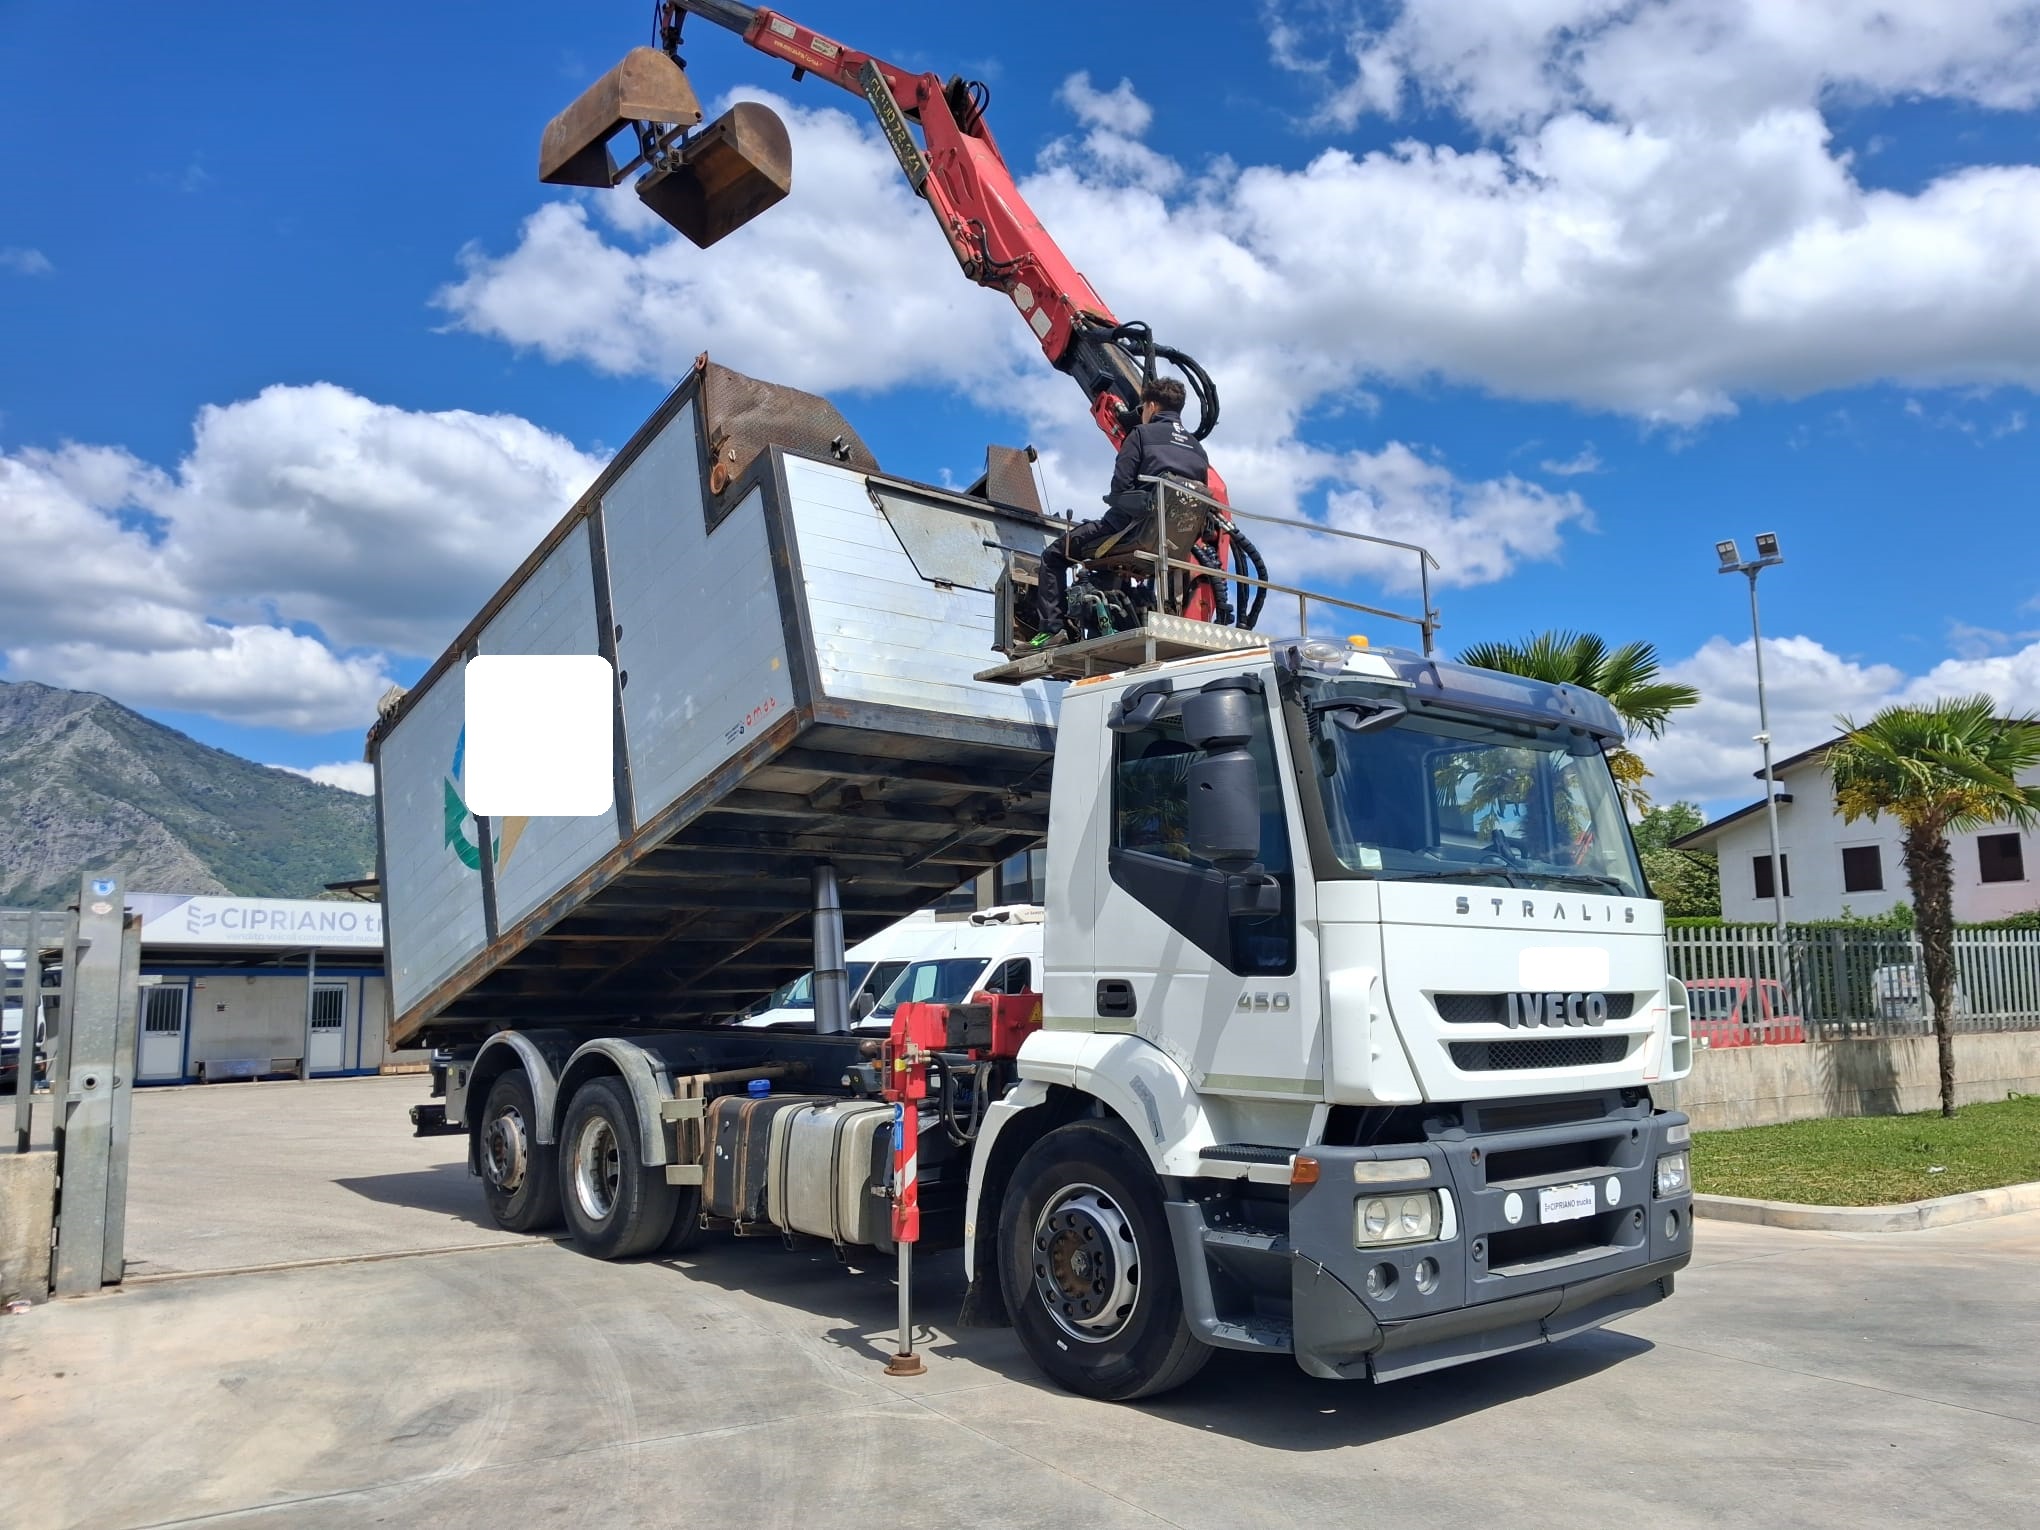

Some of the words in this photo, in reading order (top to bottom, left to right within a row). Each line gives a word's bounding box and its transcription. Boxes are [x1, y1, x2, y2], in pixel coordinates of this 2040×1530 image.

[221, 908, 358, 932] CIPRIANO
[1456, 896, 1635, 923] STRALIS
[1237, 991, 1291, 1010] 450
[1506, 991, 1608, 1029] IVECO
[1551, 1200, 1576, 1211] CIPRIANO
